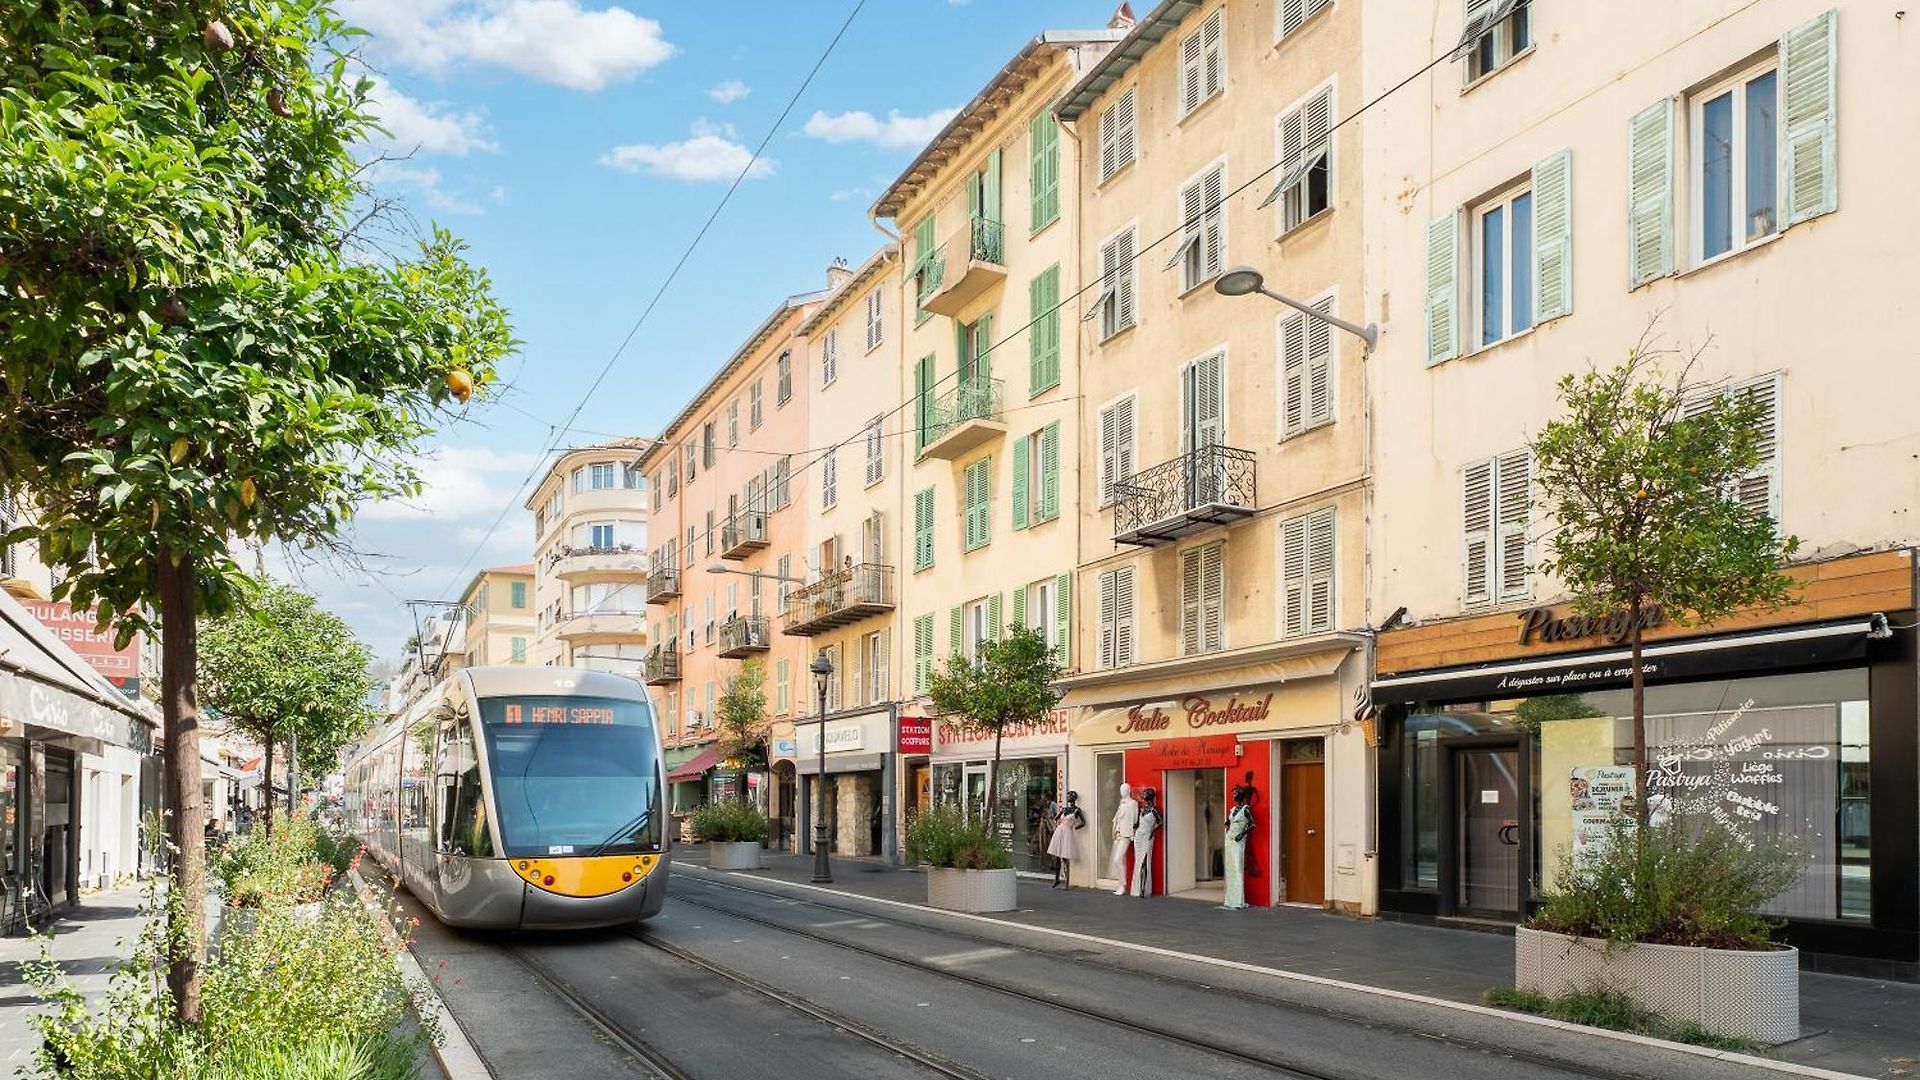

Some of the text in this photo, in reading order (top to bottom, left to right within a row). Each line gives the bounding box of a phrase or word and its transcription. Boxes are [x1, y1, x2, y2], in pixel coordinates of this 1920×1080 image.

[1509, 673, 1543, 689] déguster
[1545, 674, 1560, 684] sur
[1562, 670, 1587, 684] place
[1588, 671, 1601, 679] ou
[1604, 669, 1611, 677] à
[1613, 664, 1658, 679] empter
[532, 706, 567, 724] HENRI
[571, 708, 614, 725] SAPPIA
[1117, 693, 1273, 734] Italie Cocktail
[901, 726, 930, 734] STATION
[901, 738, 930, 746] COIFFURE
[1742, 760, 1773, 772] Liège
[1645, 769, 1712, 790] Pastrya
[1731, 773, 1783, 785] Waffles
